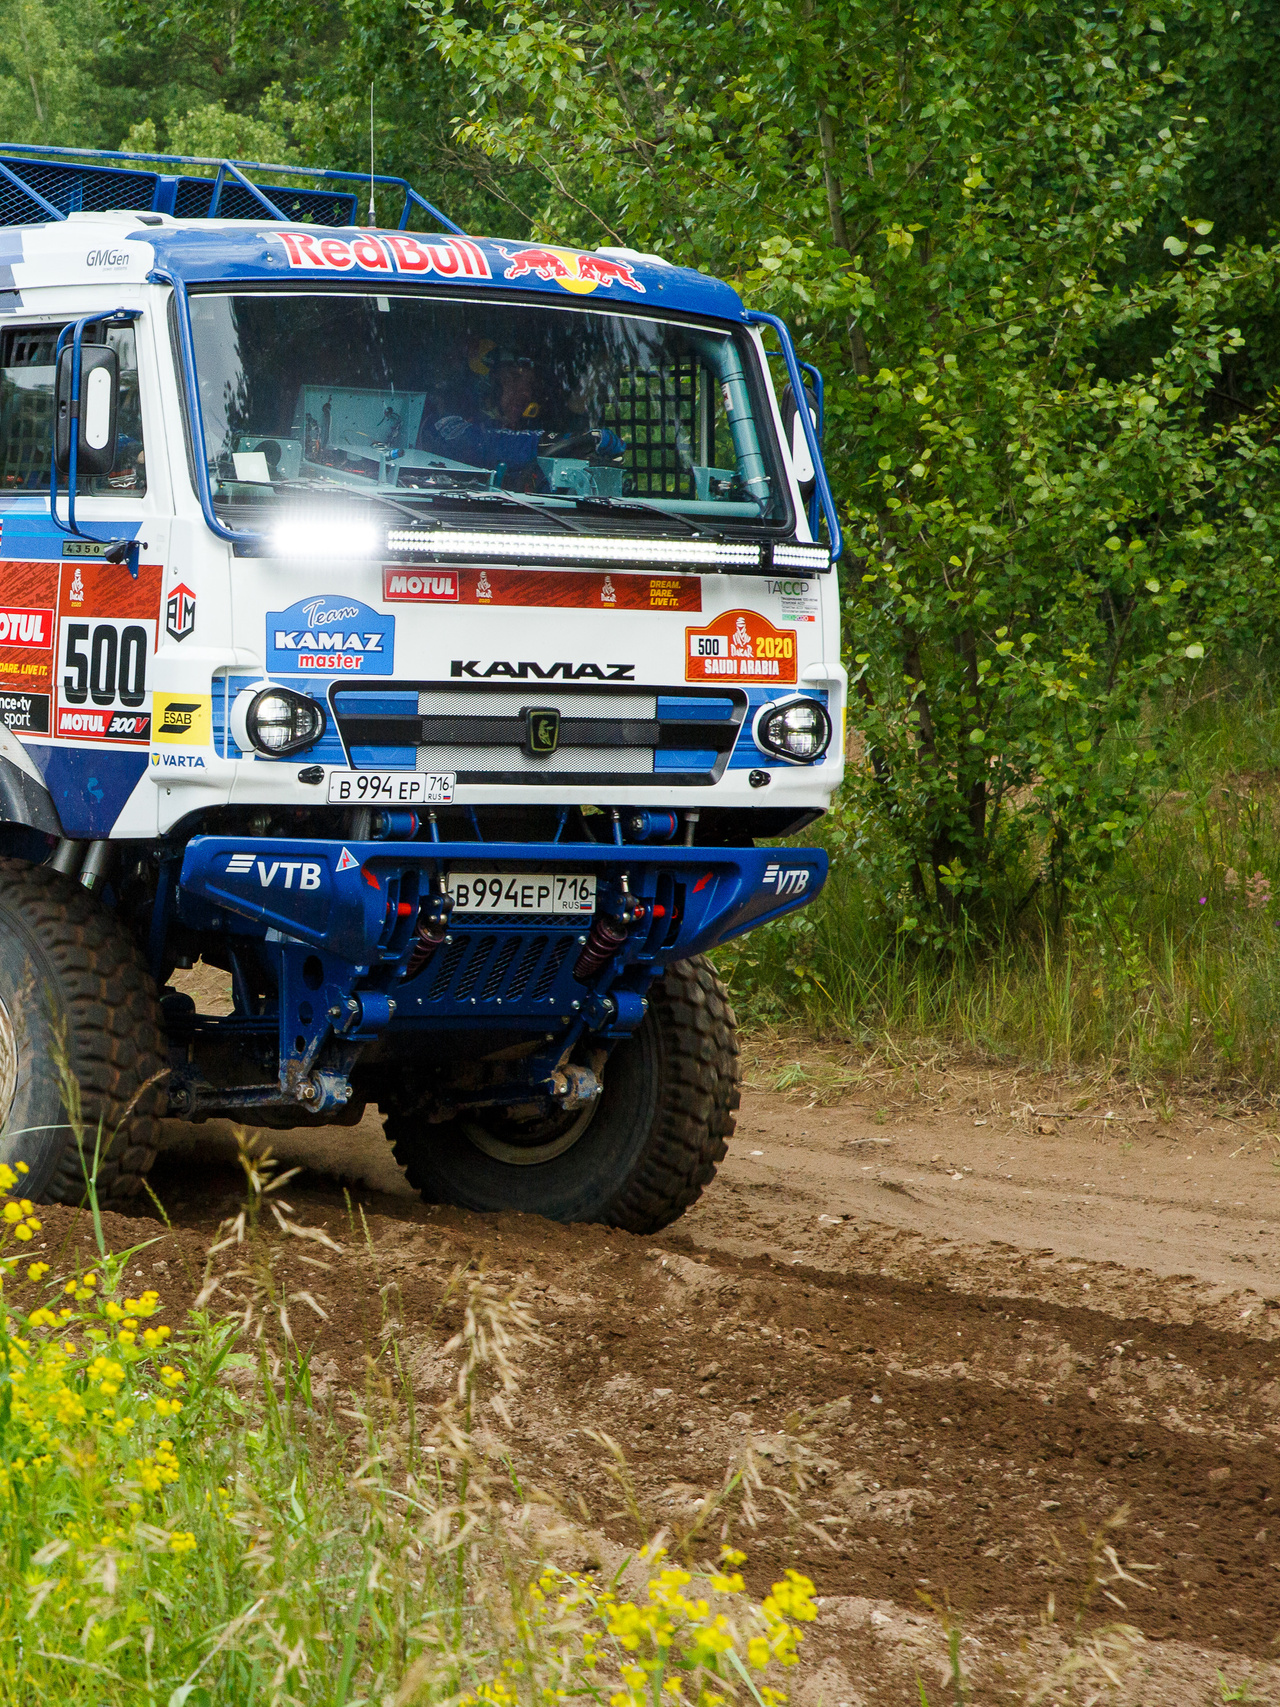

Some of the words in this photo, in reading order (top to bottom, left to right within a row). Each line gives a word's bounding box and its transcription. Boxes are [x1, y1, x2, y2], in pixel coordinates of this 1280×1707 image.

[86, 249, 129, 267] GMGen
[275, 232, 390, 270] Red
[382, 235, 490, 278] Bull
[389, 575, 455, 595] MOTUL
[649, 580, 681, 589] DREAM.
[649, 588, 674, 597] DARE.
[650, 597, 669, 606] LIVE
[669, 598, 679, 606] IT.
[302, 599, 359, 628] Team
[275, 630, 384, 652] KAMAZ
[698, 638, 719, 656] 500
[756, 637, 793, 659] 2020
[21, 664, 39, 675] LIVE
[38, 665, 49, 676] IT.
[64, 623, 148, 707] 500
[299, 653, 363, 669] master
[704, 658, 738, 675] SAUDI
[739, 659, 780, 676] ARABIA
[450, 660, 636, 681] KAMAZ
[4, 712, 31, 729] sport
[59, 712, 106, 733] MOTUL
[108, 716, 150, 734] 300V
[163, 712, 192, 724] ESAB
[162, 754, 206, 768] VARTA
[429, 776, 450, 791] 716
[257, 861, 322, 890] VTB
[775, 870, 810, 895] VTB
[556, 878, 589, 901] 716
[562, 901, 580, 909] RUS
